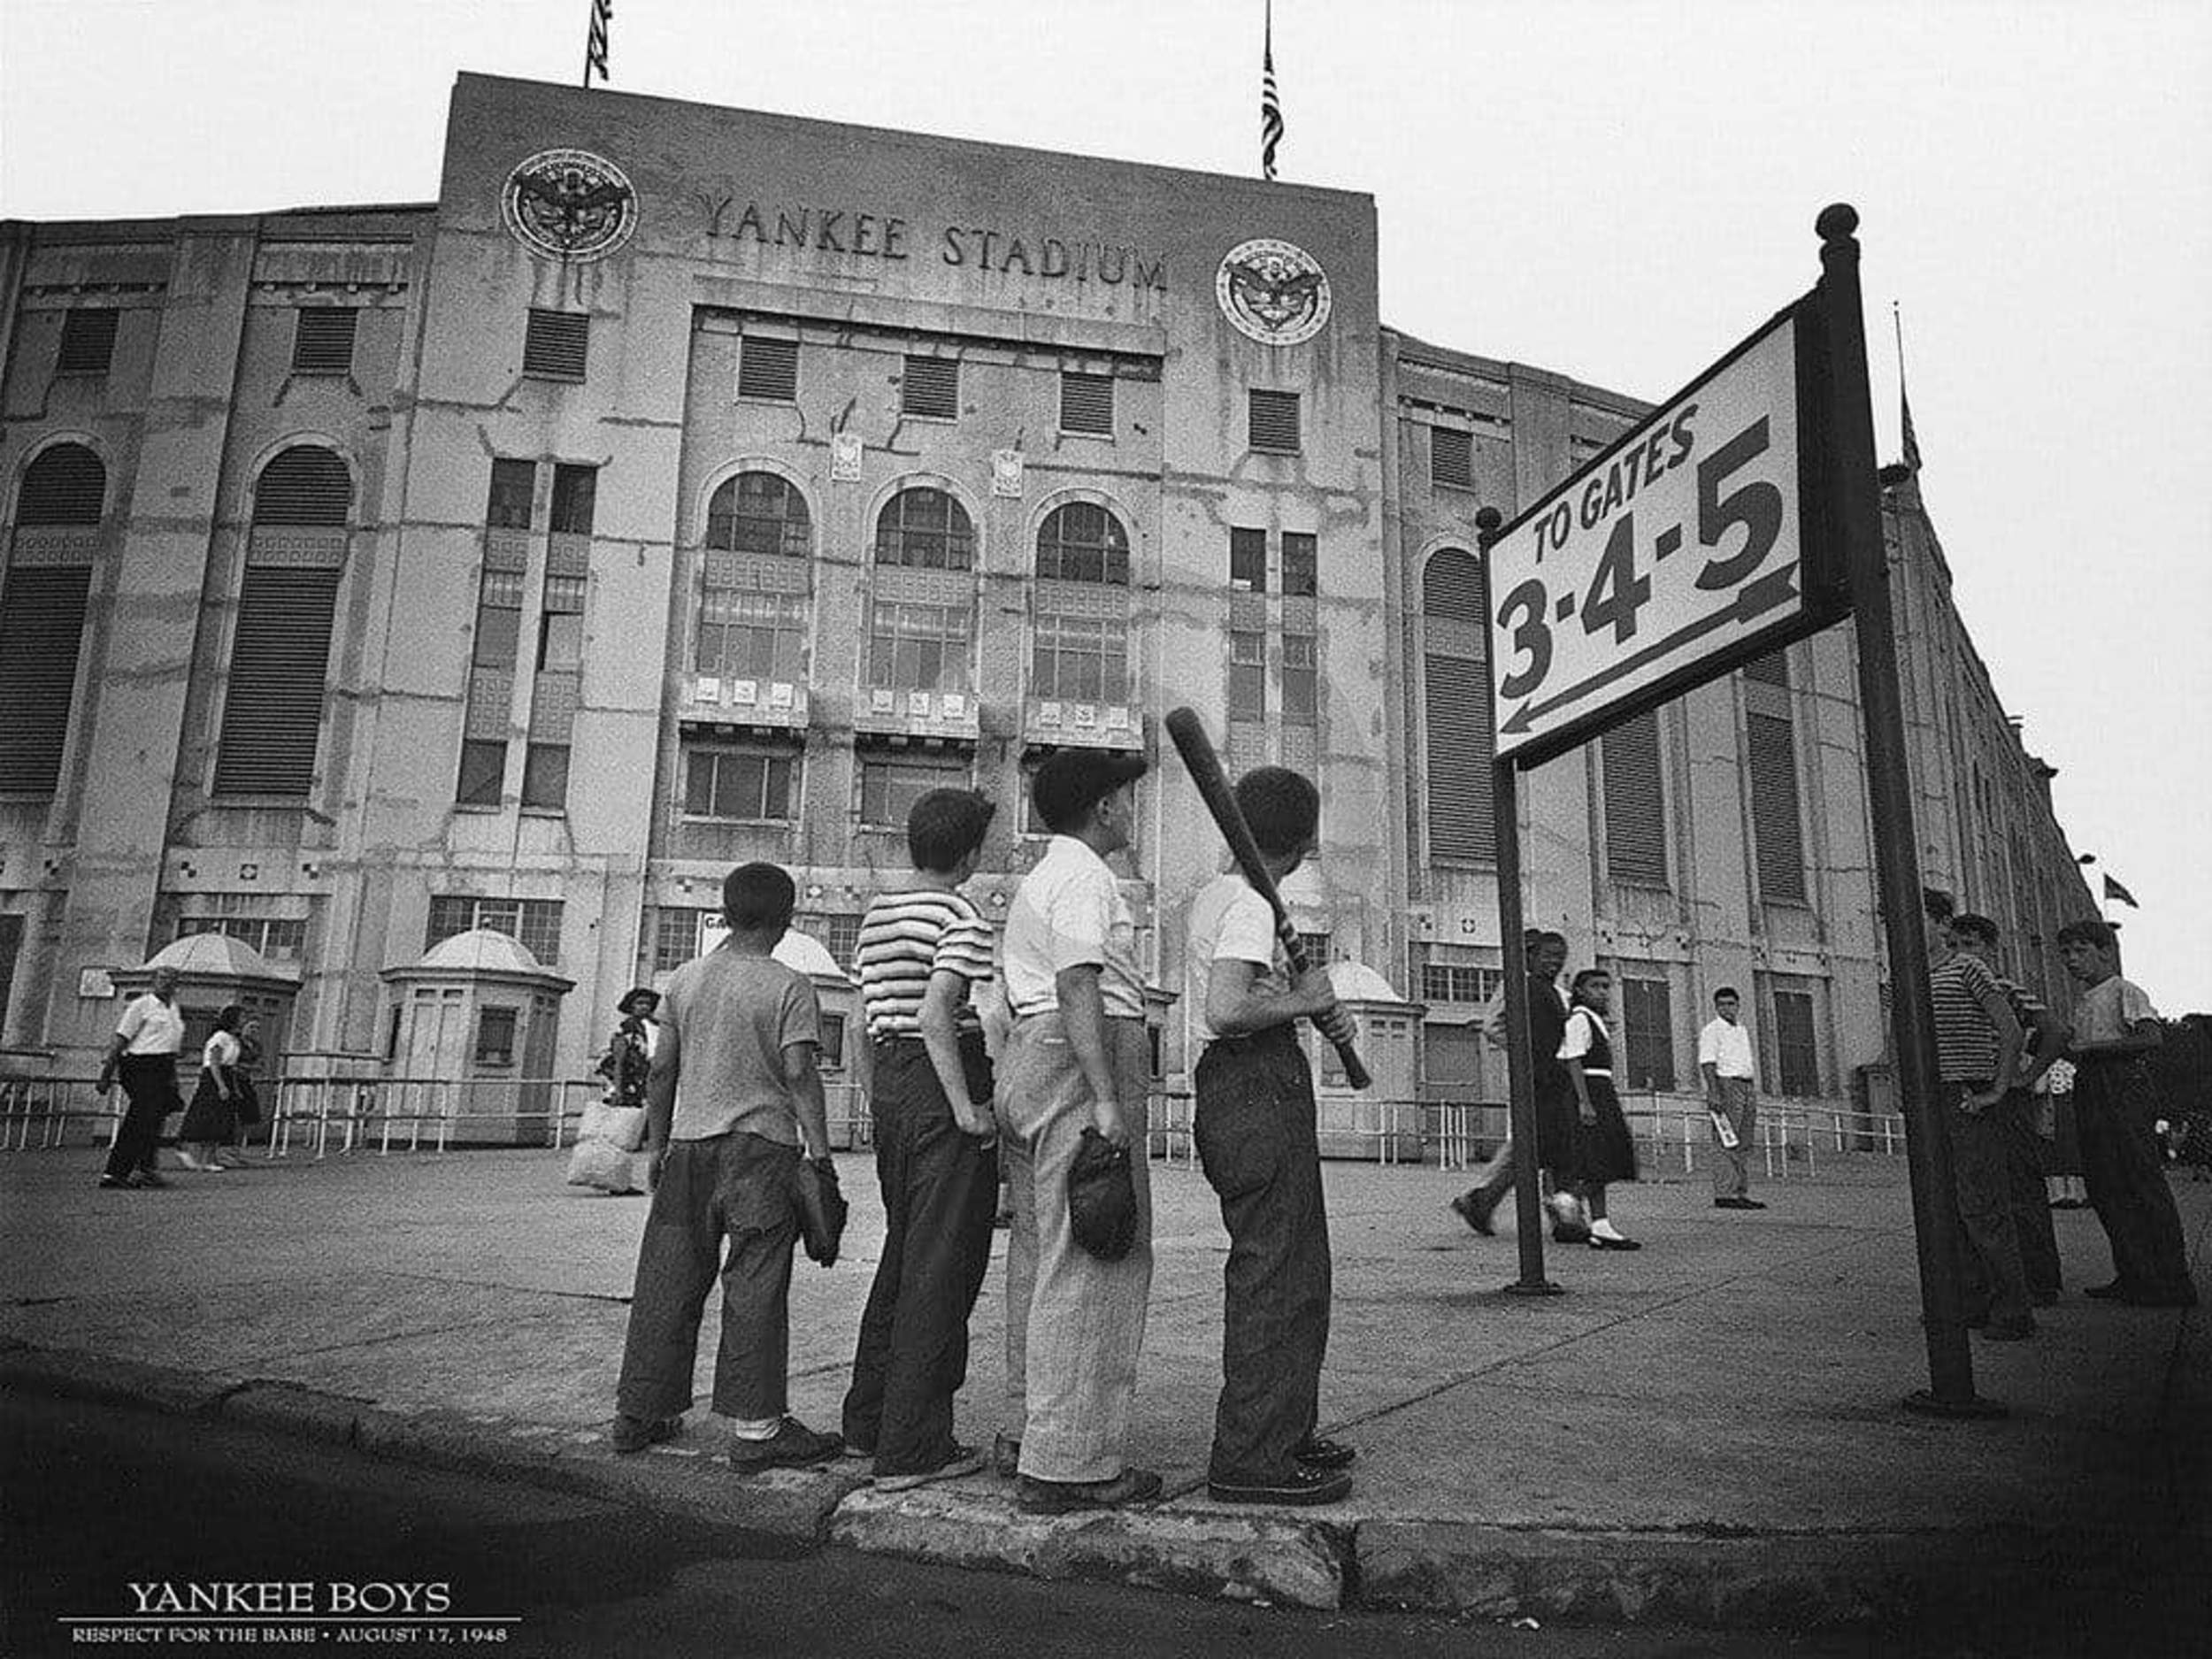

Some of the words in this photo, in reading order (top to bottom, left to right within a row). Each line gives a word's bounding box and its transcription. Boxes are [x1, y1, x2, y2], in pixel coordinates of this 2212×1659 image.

[695, 187, 908, 259] YANKEE
[943, 227, 1168, 291] STADIUM
[1497, 414, 1783, 700] 3-4-5
[1534, 501, 1571, 565] TO
[1580, 403, 1700, 530] GATES
